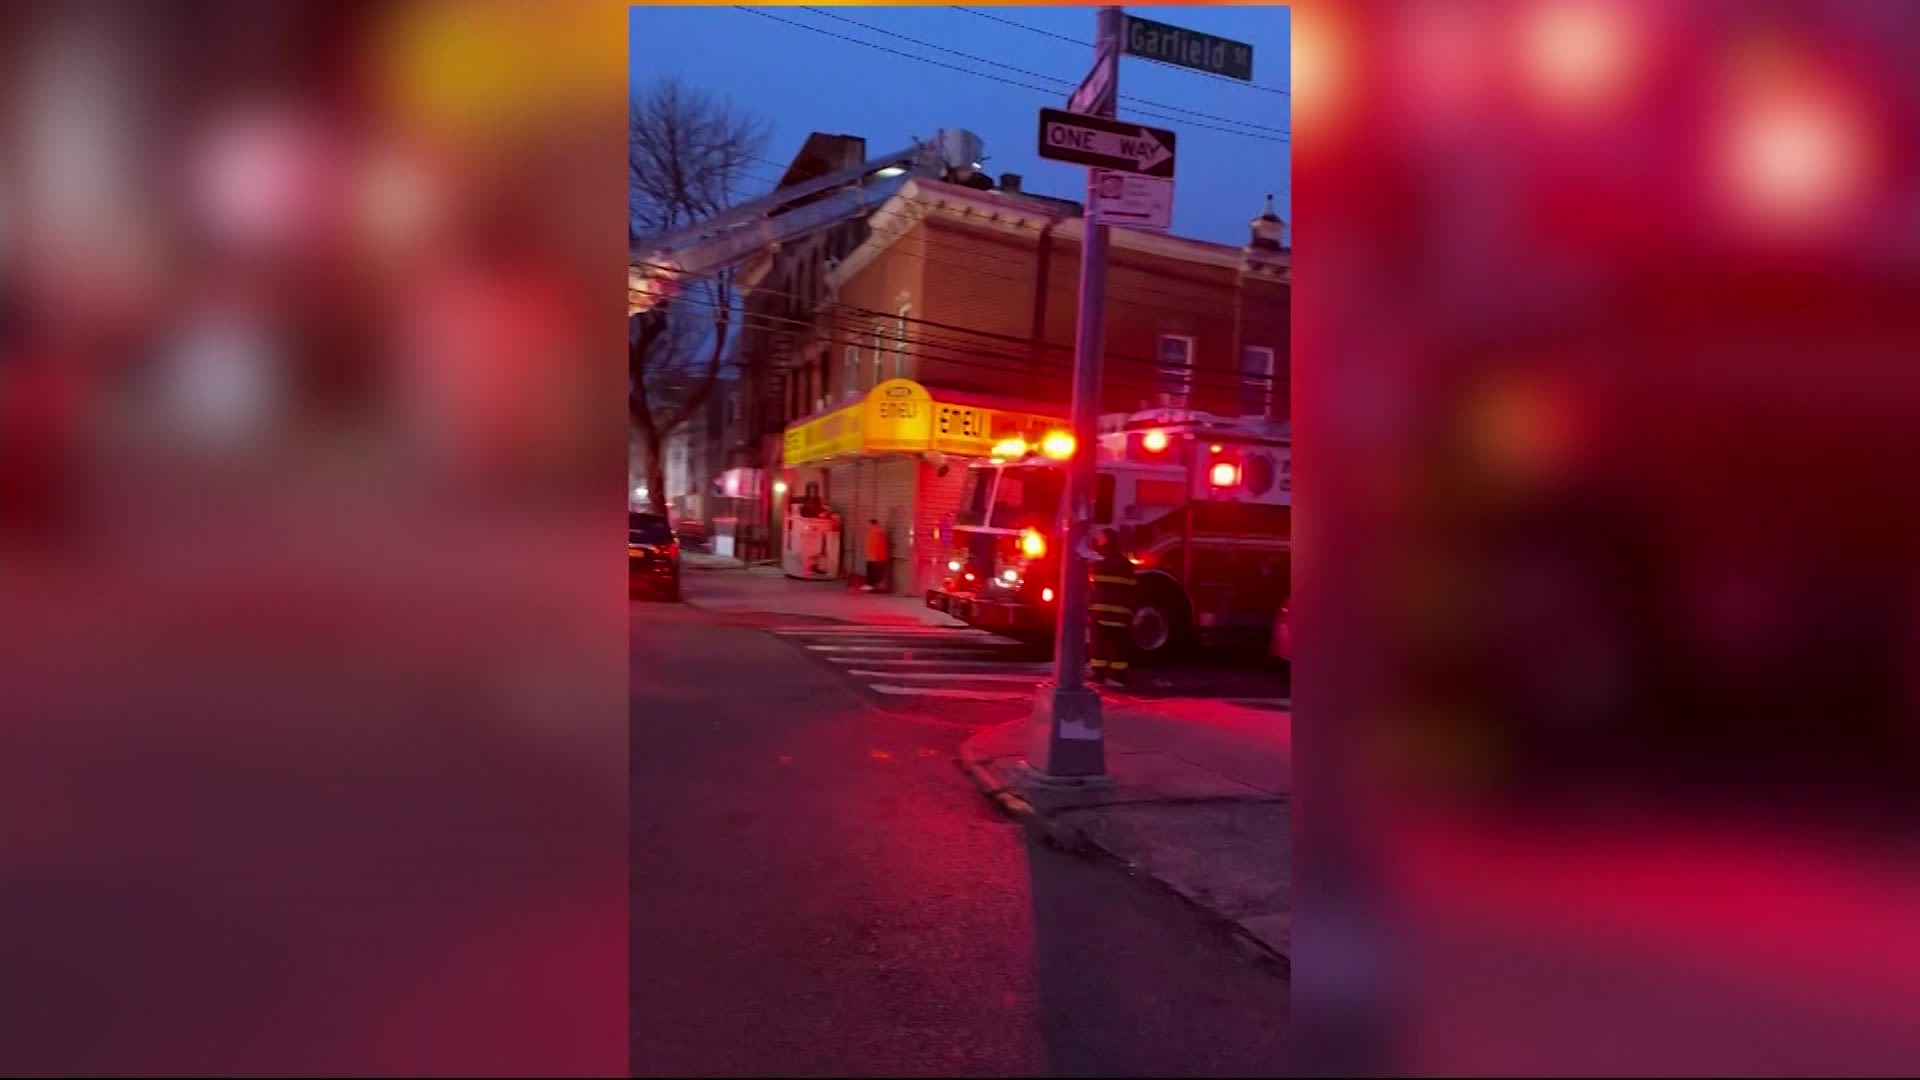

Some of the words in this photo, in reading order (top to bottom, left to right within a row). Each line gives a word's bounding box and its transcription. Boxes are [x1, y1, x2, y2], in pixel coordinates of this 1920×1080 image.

[1132, 22, 1225, 68] Garfield
[1051, 126, 1095, 150] ONE
[1120, 138, 1162, 159] WAY
